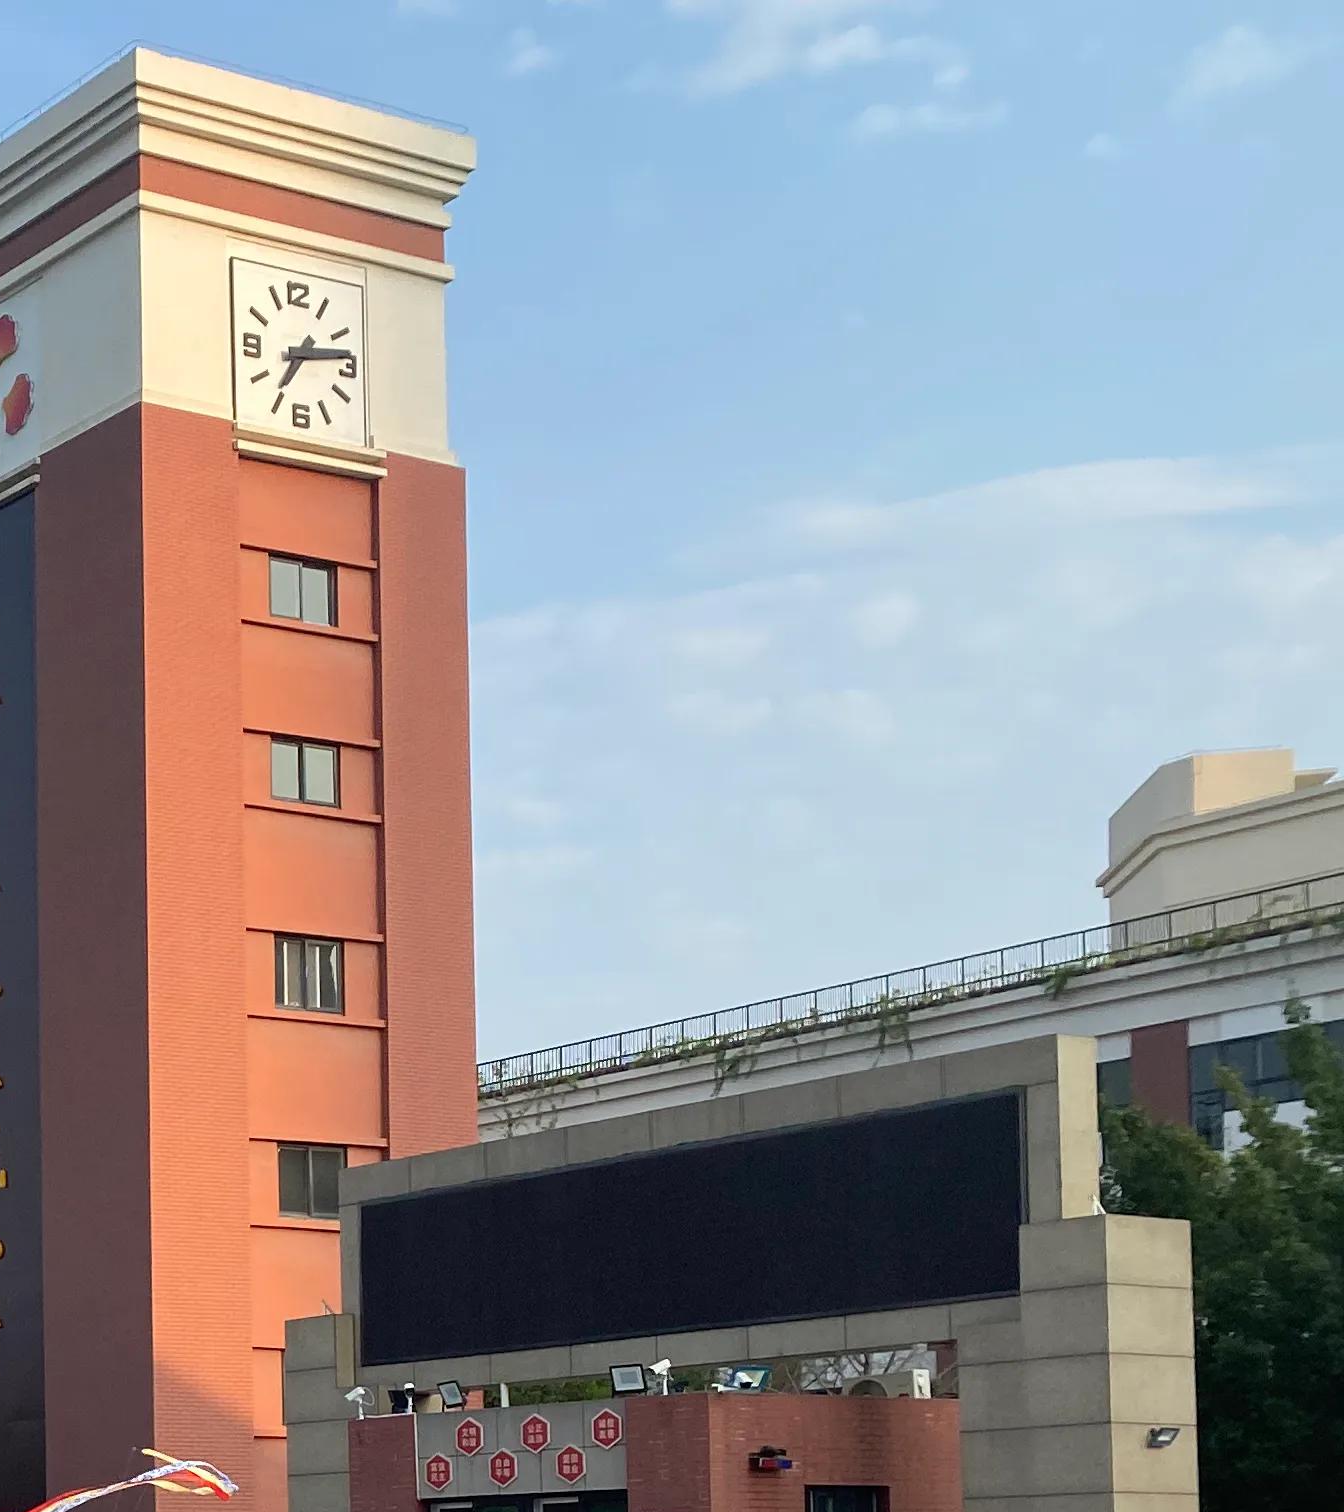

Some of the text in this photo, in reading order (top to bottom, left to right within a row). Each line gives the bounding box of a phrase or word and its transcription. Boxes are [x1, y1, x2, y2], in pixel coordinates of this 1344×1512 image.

[287, 281, 310, 309] 12
[243, 332, 261, 359] 9
[338, 355, 357, 378] 3
[292, 403, 310, 429] 6
